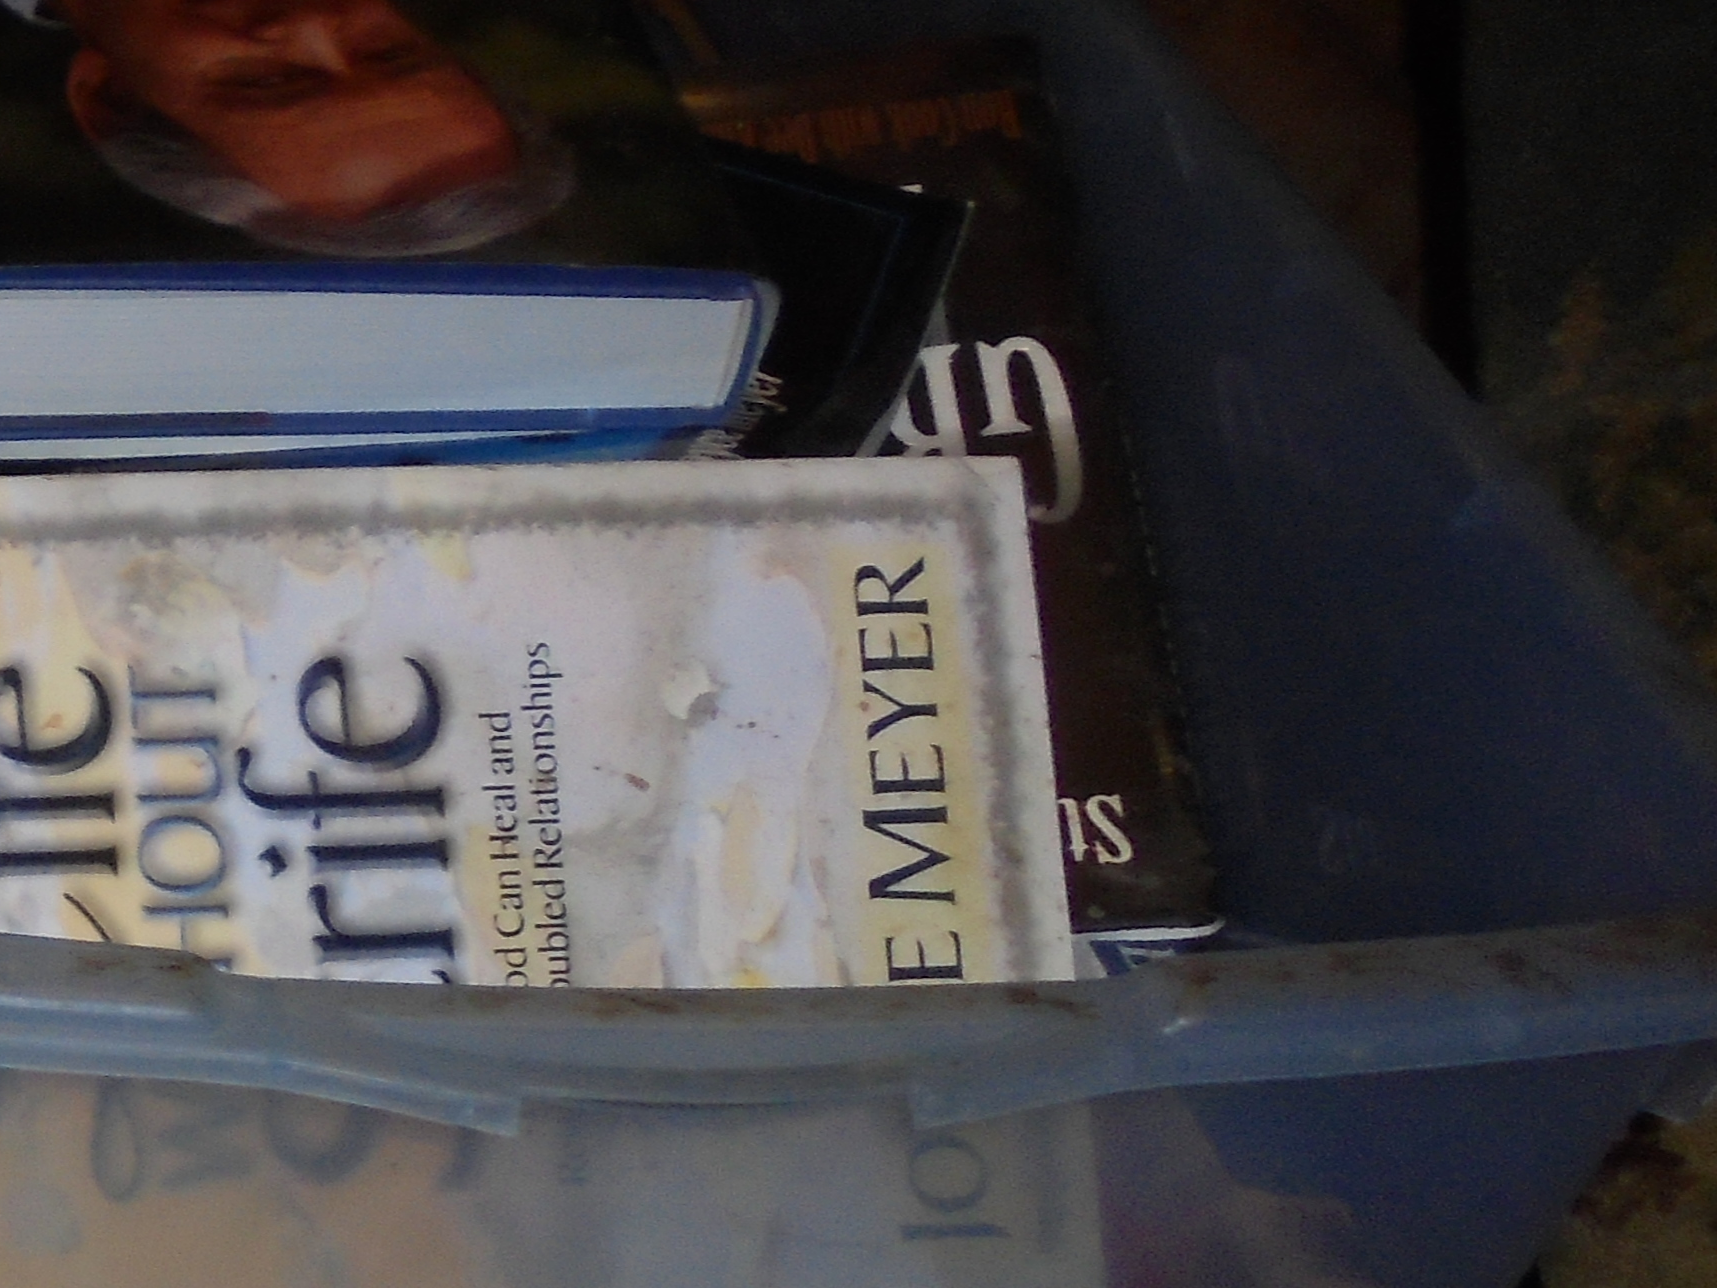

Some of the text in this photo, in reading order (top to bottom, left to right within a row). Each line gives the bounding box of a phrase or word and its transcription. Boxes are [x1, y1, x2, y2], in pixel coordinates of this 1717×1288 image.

[476, 710, 530, 986] od Can Heal and
[518, 641, 565, 869] Relationships
[852, 554, 956, 905] MEYER
